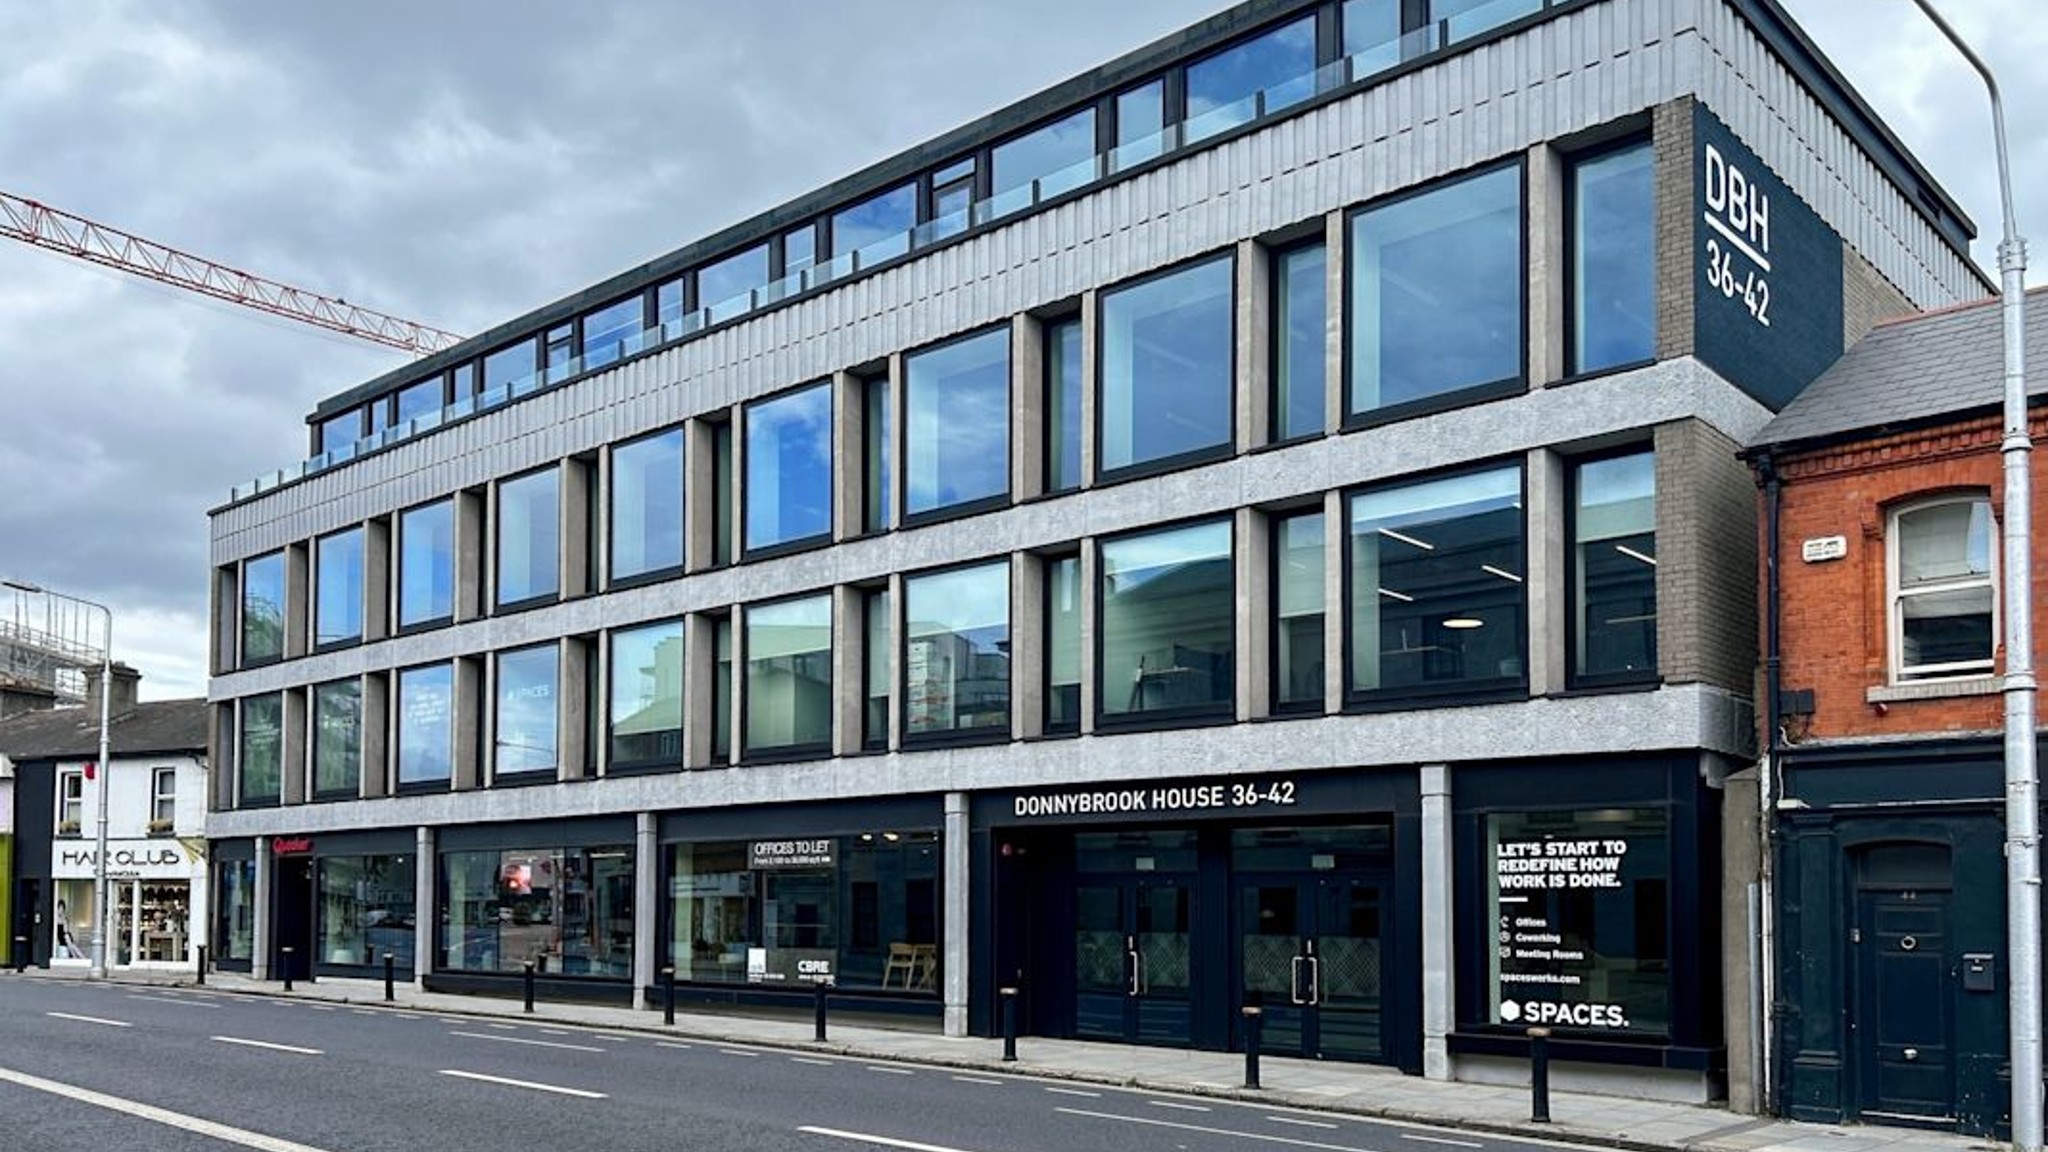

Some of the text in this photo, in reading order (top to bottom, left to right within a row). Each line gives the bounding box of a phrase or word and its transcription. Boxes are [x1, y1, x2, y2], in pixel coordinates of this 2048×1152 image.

[1705, 143, 1769, 254] DBH
[1706, 239, 1771, 327] 36-42
[1014, 781, 1296, 816] DONNYBROOK HOUSE 36-42
[754, 840, 830, 855] OFFICES TO LET
[1497, 840, 1627, 857] LET'S START TO
[115, 850, 180, 866] CLUB
[1497, 857, 1620, 872] REDEFINE HOW
[1498, 873, 1622, 888] WORK IS DONE.
[1516, 917, 1547, 927] Offices
[1516, 933, 1561, 944] Coworking
[1516, 949, 1584, 960] Meeting Rooms
[797, 960, 830, 974] CBRE
[1498, 973, 1581, 985] spacesworks.com
[1524, 1002, 1630, 1027] SPACES.
